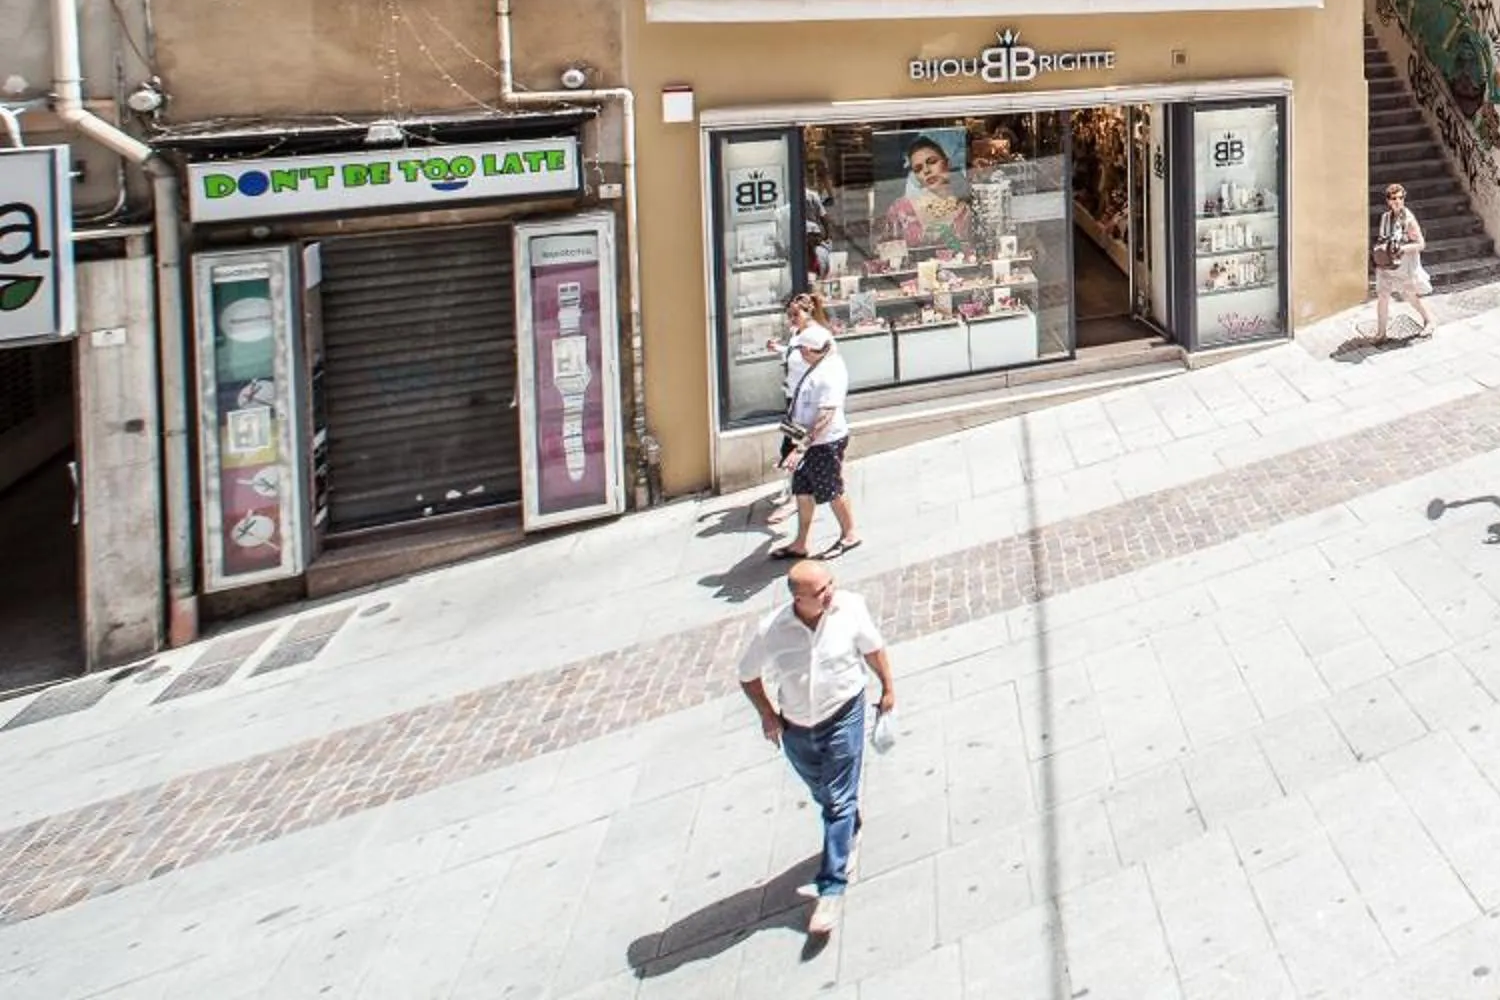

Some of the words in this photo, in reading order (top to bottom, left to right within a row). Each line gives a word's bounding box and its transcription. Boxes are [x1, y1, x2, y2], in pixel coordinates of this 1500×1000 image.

[908, 56, 978, 83] BIJOU
[204, 165, 334, 200] DON'T
[342, 161, 391, 188] BE
[398, 156, 475, 184] TOO
[482, 149, 566, 177] LATE
